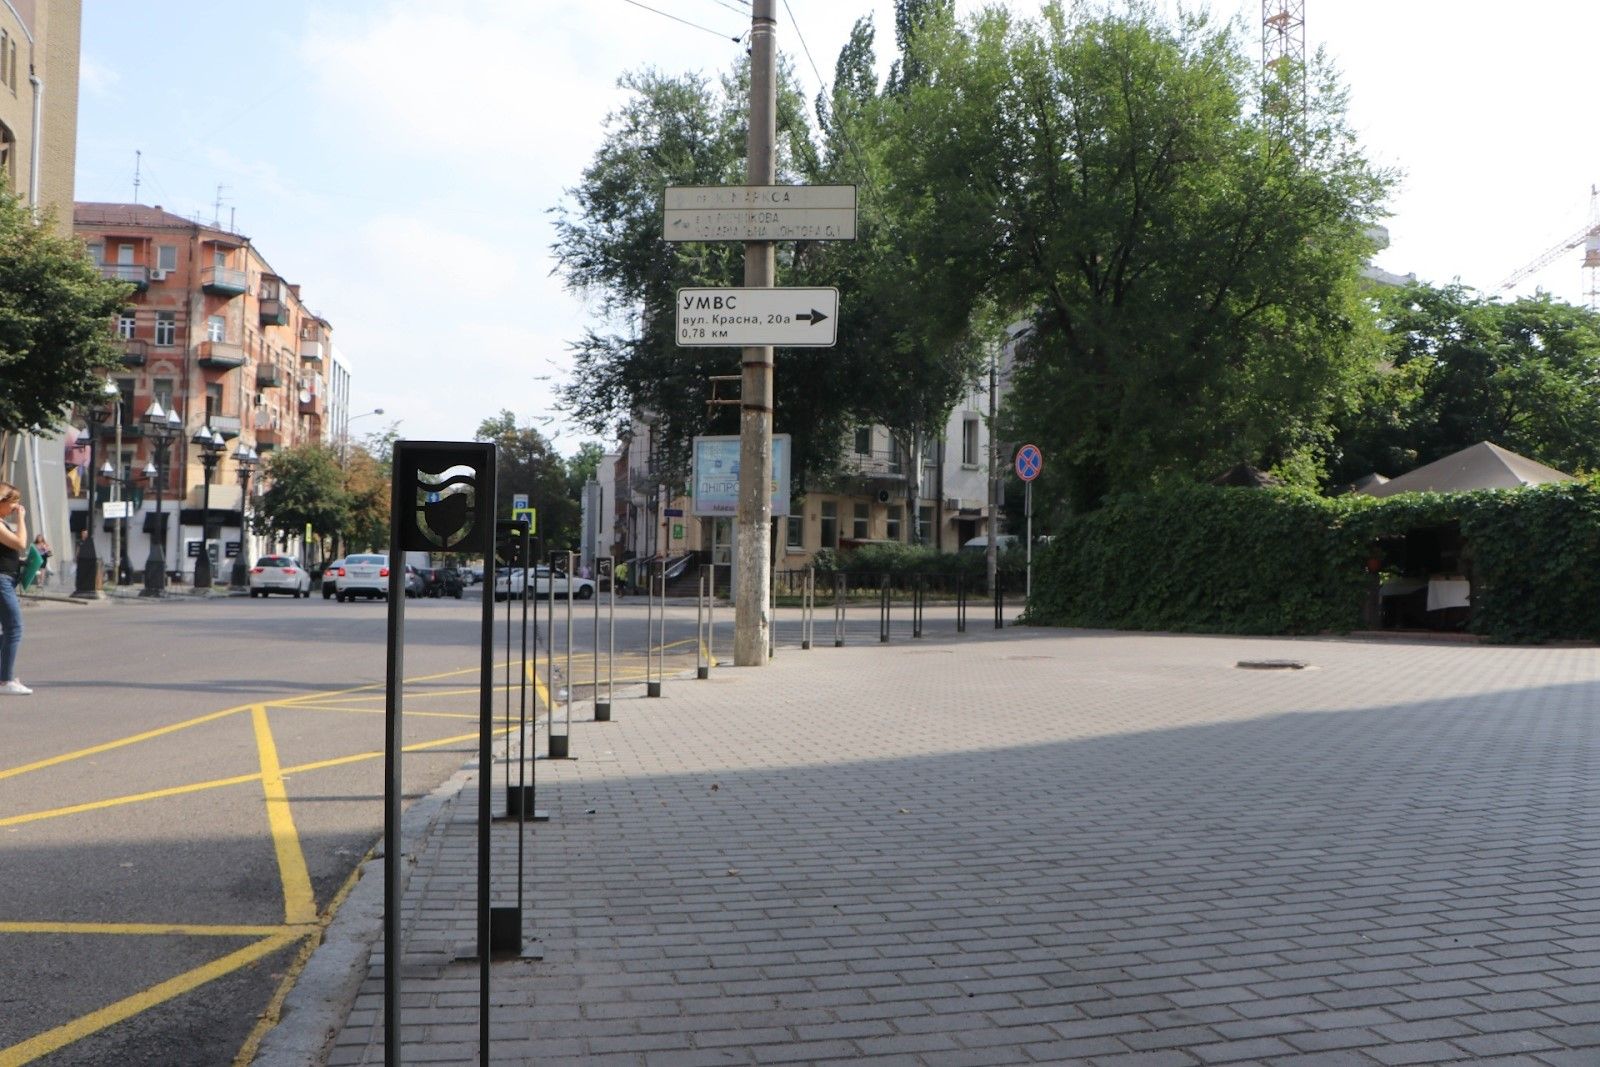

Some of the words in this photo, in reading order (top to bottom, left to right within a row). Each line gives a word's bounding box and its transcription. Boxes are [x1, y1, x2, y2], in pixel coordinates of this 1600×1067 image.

[683, 296, 737, 310] УМВС
[682, 316, 709, 326] вул.
[712, 314, 762, 326] Красна,
[767, 314, 791, 324] 20а
[681, 328, 706, 339] 0,78
[711, 330, 728, 338] км
